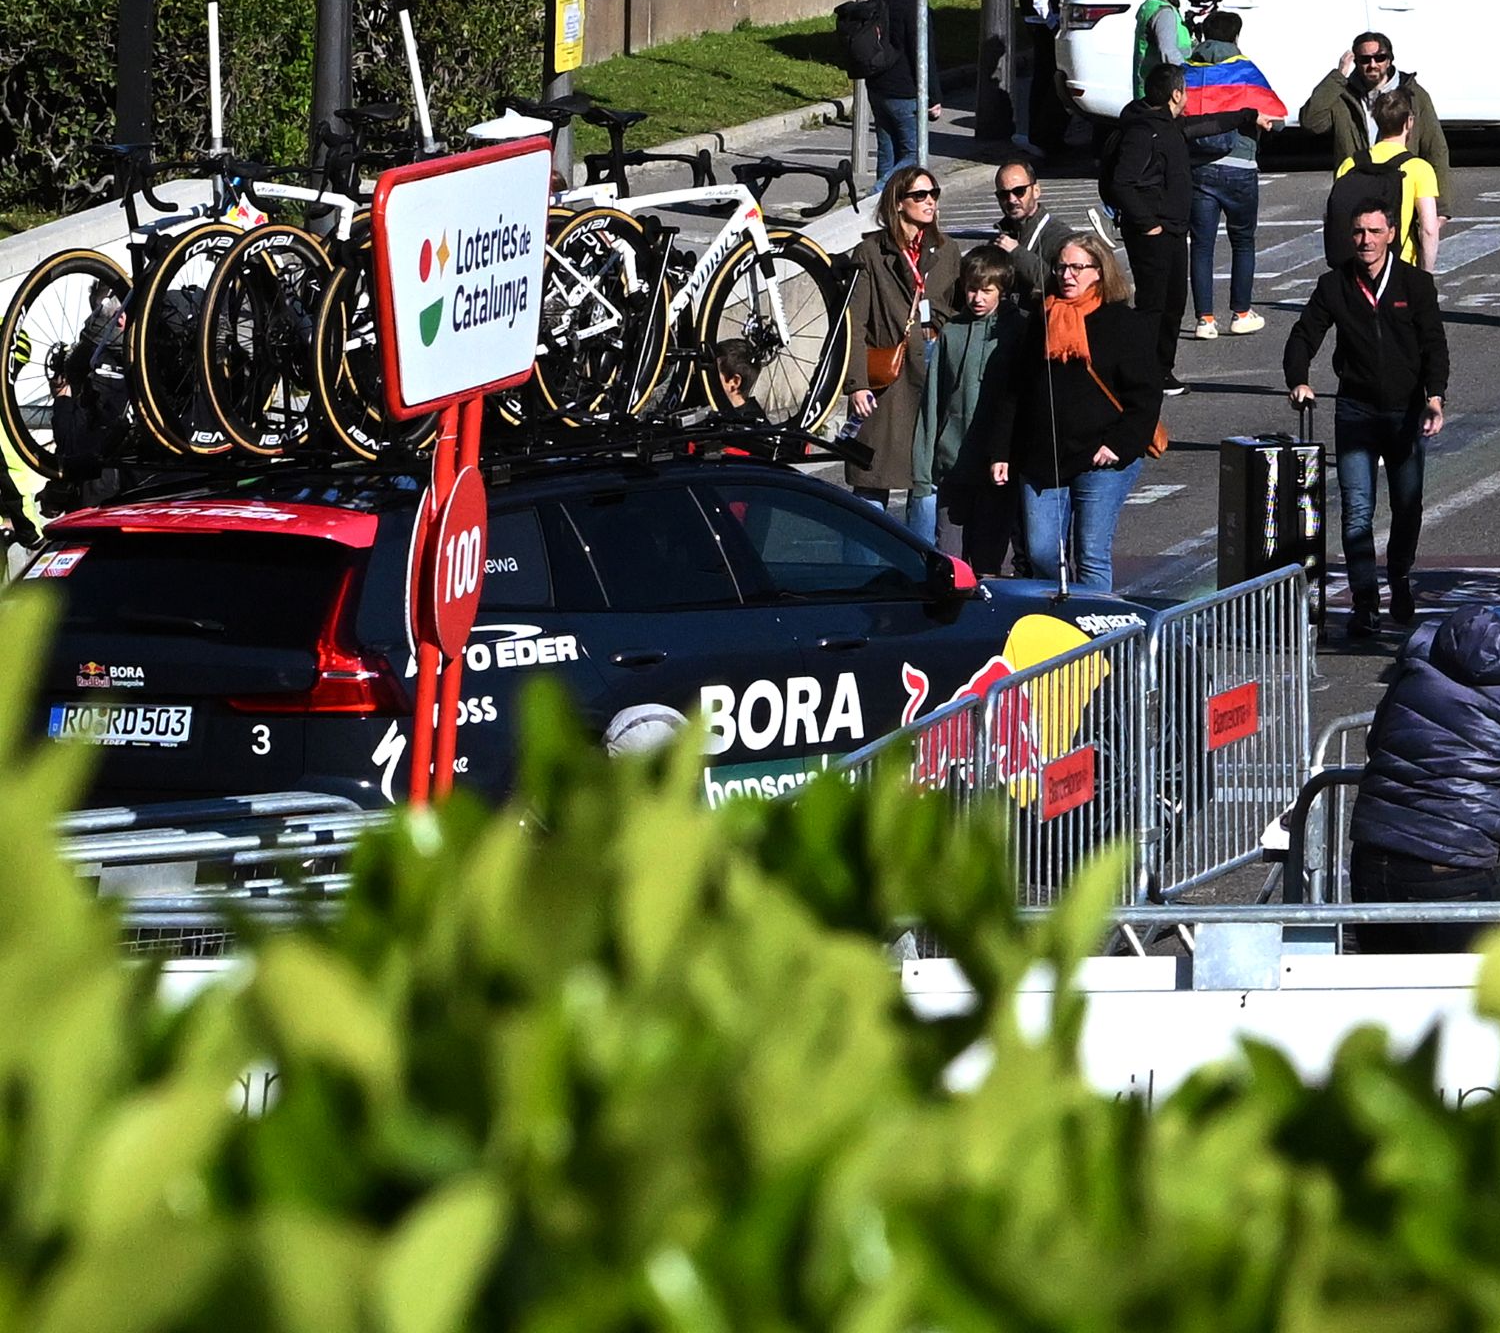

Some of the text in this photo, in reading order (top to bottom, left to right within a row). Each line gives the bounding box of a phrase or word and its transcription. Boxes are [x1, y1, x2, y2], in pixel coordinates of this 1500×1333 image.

[242, 234, 294, 262] roval
[456, 214, 532, 275] Loteries de
[451, 274, 529, 330] Catalunya
[444, 526, 483, 603] 100
[483, 554, 519, 575] ewa
[496, 634, 579, 669] EDER
[109, 666, 145, 680] BORA
[702, 672, 865, 755] BORA
[251, 725, 271, 756] 3
